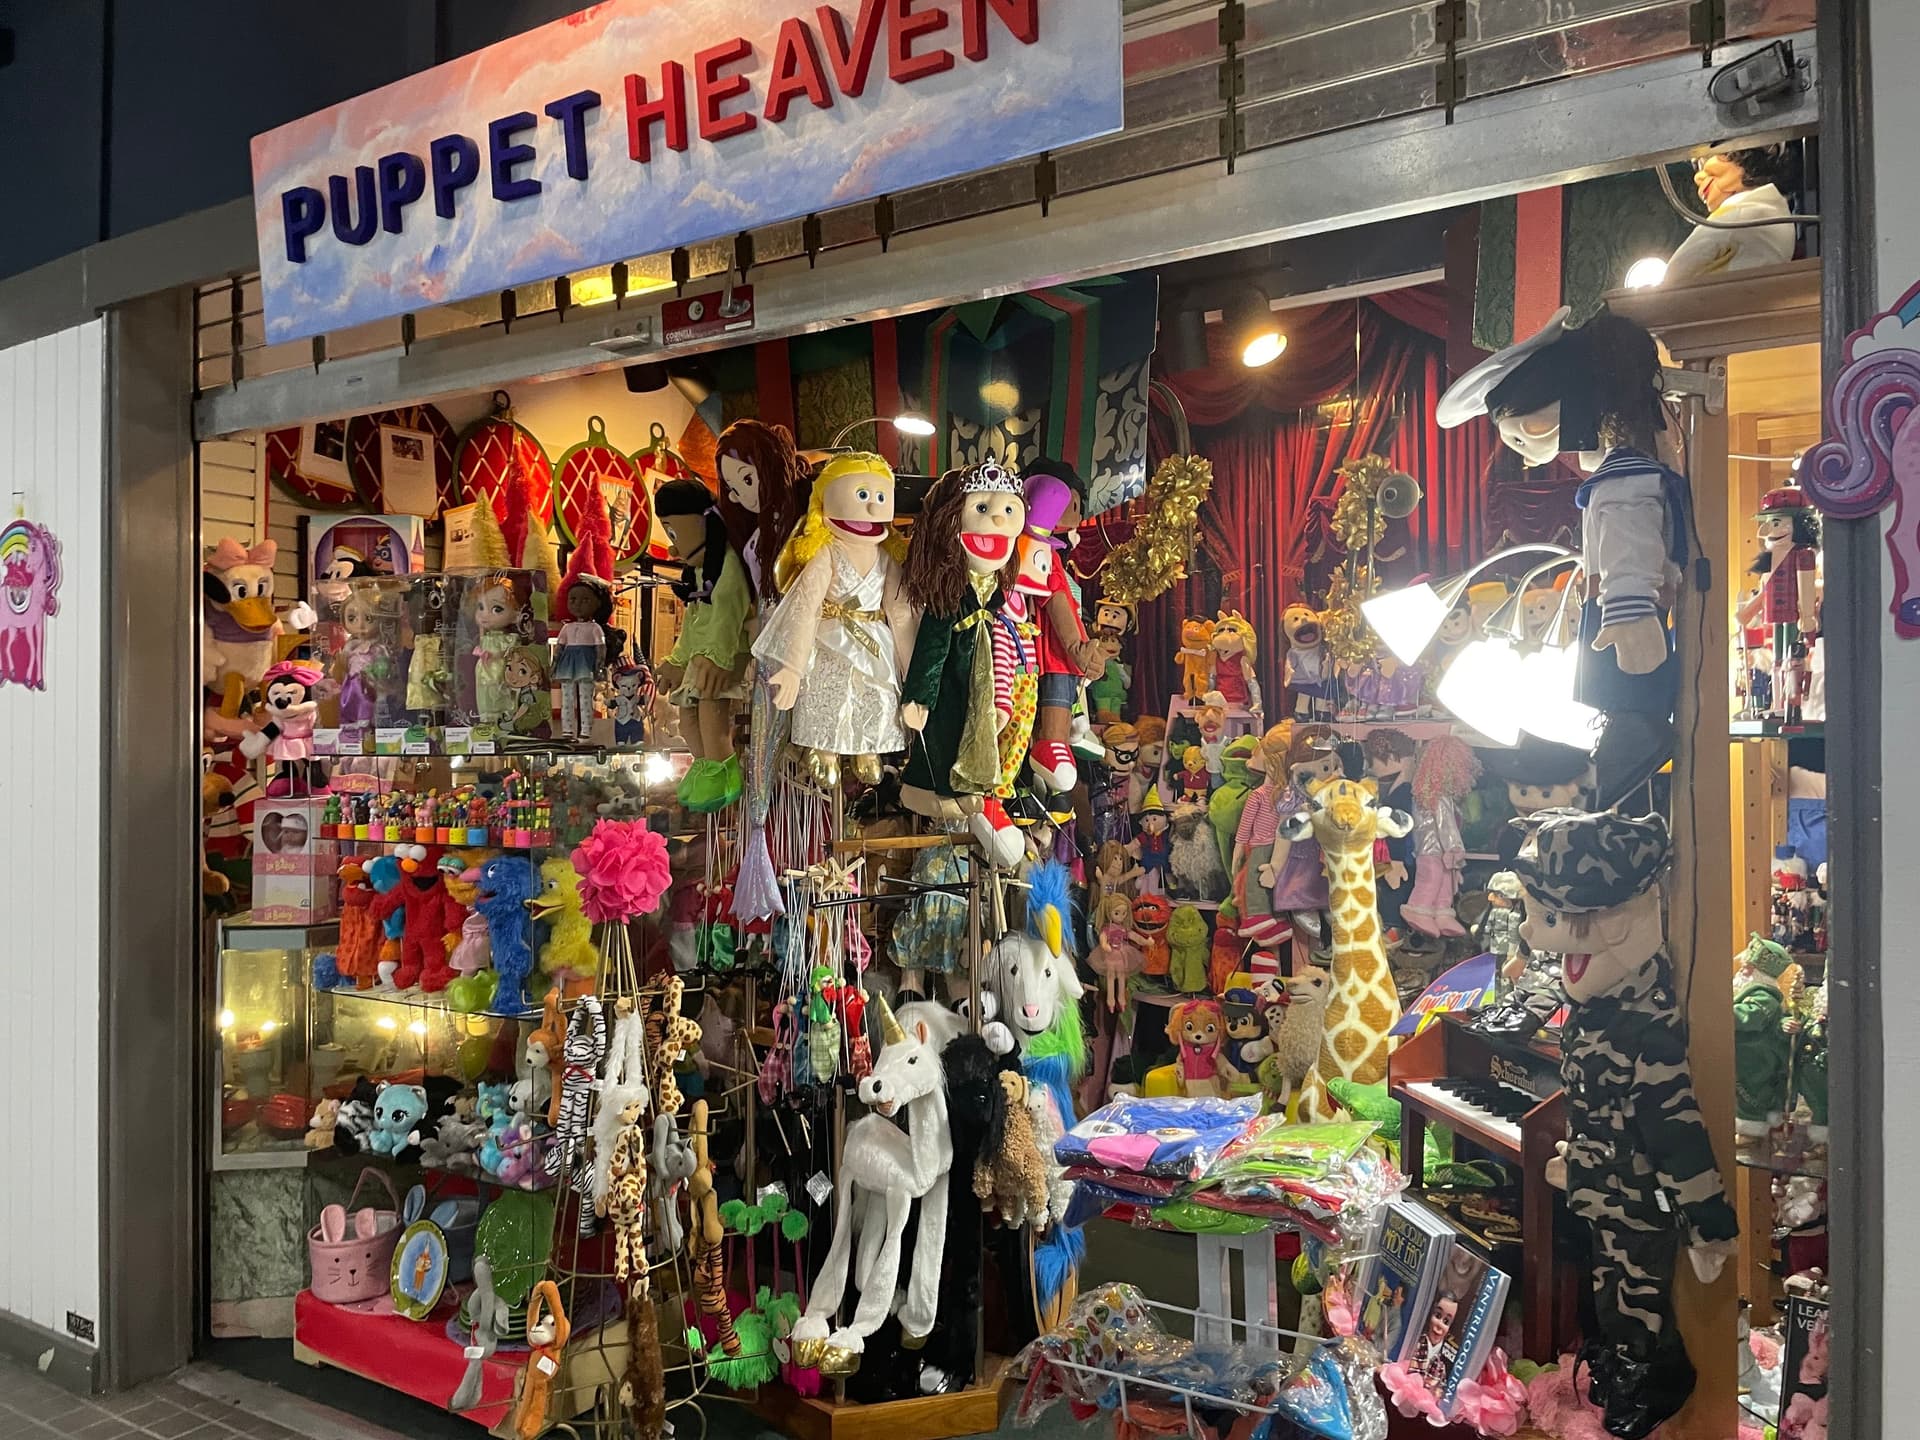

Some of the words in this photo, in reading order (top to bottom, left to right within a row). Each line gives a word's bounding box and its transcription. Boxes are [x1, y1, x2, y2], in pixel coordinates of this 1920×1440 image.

[282, 90, 601, 263] PUPPET
[623, 0, 1039, 163] HEAVEN
[1411, 987, 1482, 1016] AWESOME
[1442, 1273, 1499, 1404] VENTRILOQUISM
